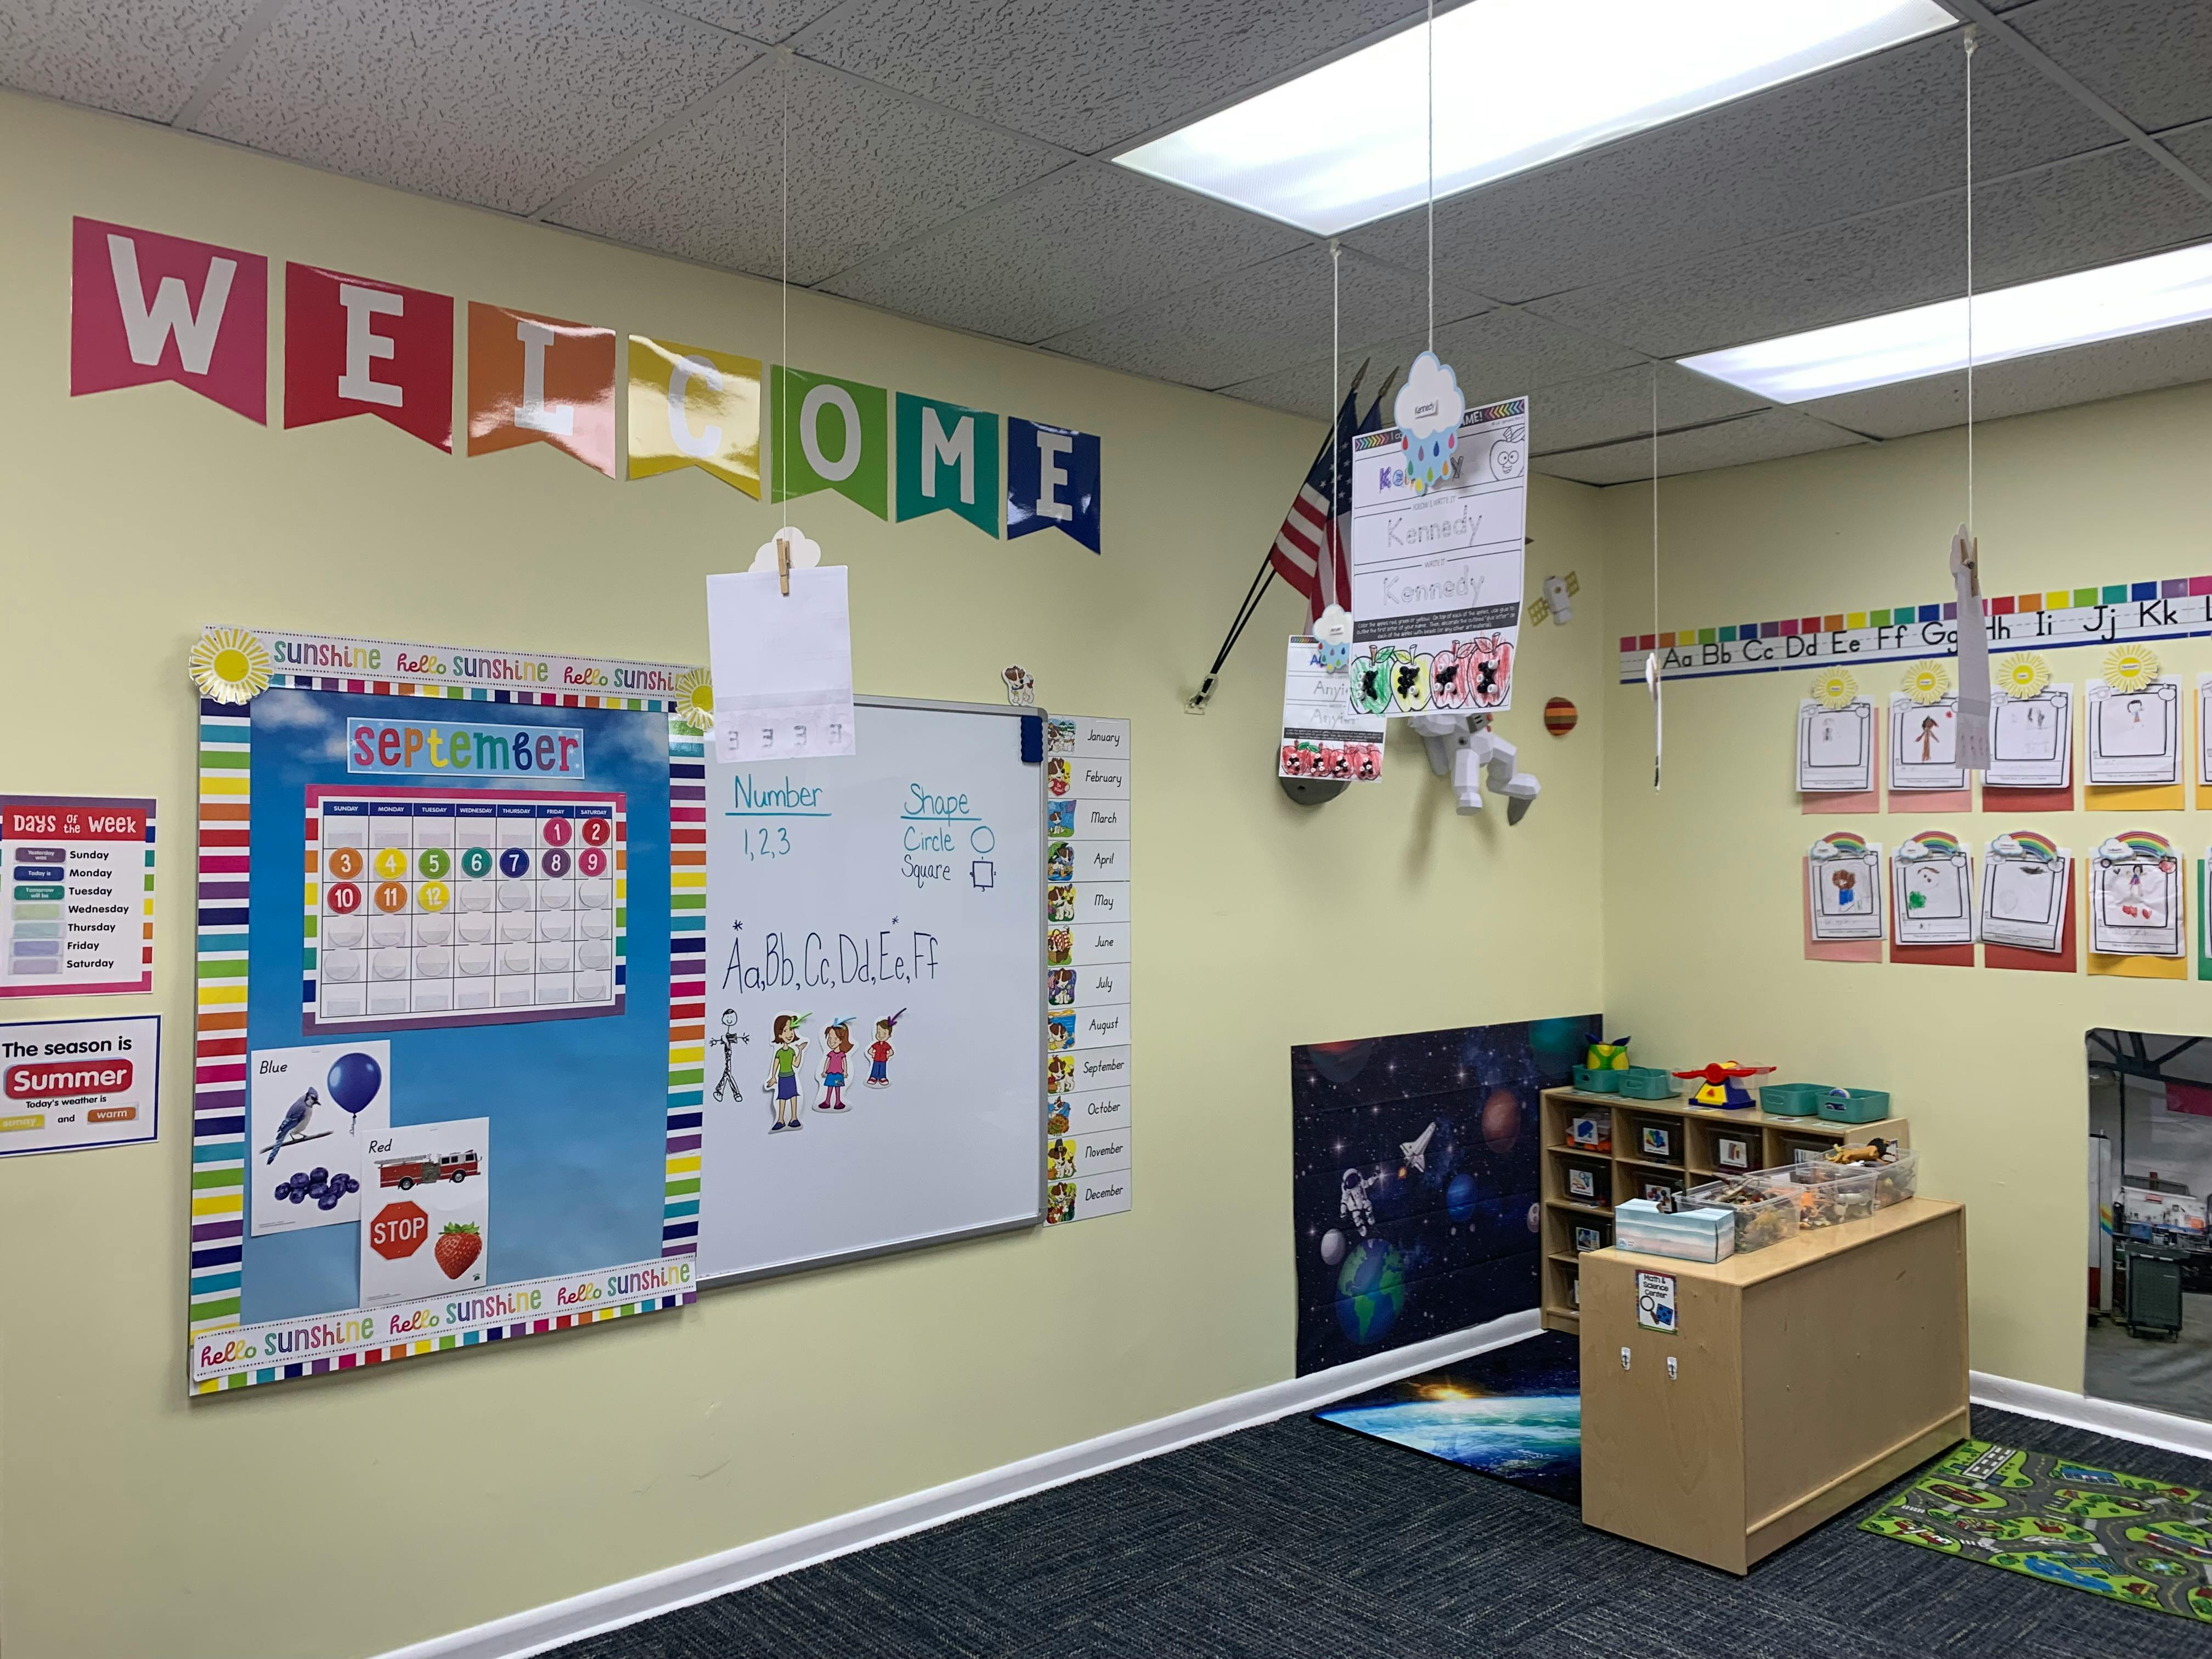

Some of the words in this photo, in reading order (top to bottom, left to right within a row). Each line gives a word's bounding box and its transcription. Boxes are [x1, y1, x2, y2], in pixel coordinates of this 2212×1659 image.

[106, 233, 1073, 522] WELCOME
[1388, 505, 1482, 548] Kennedy
[1383, 565, 1485, 608] Kennedy
[1663, 647, 1692, 669] Aa
[1702, 643, 1731, 665] Bb
[1743, 640, 1774, 661] Cc
[1786, 633, 1816, 658] Dd
[1832, 630, 1860, 654] Ee
[1877, 625, 1908, 650] Ff
[2036, 611, 2052, 636] Ii
[2084, 605, 2116, 641] Jj
[2140, 599, 2178, 627] Kk
[274, 640, 381, 670] sunshine
[397, 652, 447, 675] hello
[453, 656, 548, 682] sunshine
[564, 665, 608, 686] hello
[1087, 730, 1120, 747] January
[1085, 770, 1122, 788] February
[735, 774, 822, 809] Number
[904, 783, 970, 827] Shape
[1091, 812, 1117, 824] March
[554, 823, 561, 840] 1
[592, 823, 600, 840] 2
[744, 827, 790, 861] 1,2,3
[904, 826, 955, 852] Circle
[69, 851, 109, 861] Sunday
[341, 854, 351, 871] 3
[385, 855, 396, 871] 4
[430, 855, 439, 872] 5
[472, 854, 482, 870] 6
[510, 855, 520, 872] 7
[551, 854, 560, 871] 8
[588, 854, 597, 870] 9
[1094, 853, 1115, 869] April
[69, 869, 112, 879] Monday
[901, 855, 951, 888] Square
[69, 887, 112, 897] Tuesday
[335, 889, 354, 907] 10
[385, 888, 397, 906] 11
[426, 888, 442, 905] 12
[68, 905, 129, 915] Wednesday
[1094, 894, 1114, 910] May
[67, 923, 116, 933] Thursday
[67, 941, 99, 951] Friday
[1094, 936, 1114, 947] June
[66, 960, 114, 969] Saturday
[1096, 977, 1113, 992] July
[1088, 1017, 1119, 1035] August
[2, 1041, 38, 1058] The
[44, 1040, 112, 1055] season
[118, 1036, 132, 1051] is
[259, 1061, 287, 1074] Blue
[1083, 1059, 1125, 1077] September
[14, 1069, 127, 1092] Summer
[26, 1098, 59, 1109] Today's
[61, 1096, 98, 1106] weather
[1088, 1103, 1121, 1115] October
[58, 1114, 75, 1123] and
[97, 1109, 128, 1119] warm
[369, 1139, 392, 1154] Red
[1085, 1144, 1124, 1158] November
[1085, 1186, 1124, 1201] December
[374, 1217, 425, 1245] STOP
[1643, 1282, 1669, 1291] Science
[1645, 1289, 1668, 1299] Center
[201, 1340, 257, 1367] hello
[264, 1317, 374, 1356] sunshine
[390, 1309, 439, 1334] hello
[447, 1289, 541, 1324] sunshine
[558, 1282, 601, 1306] hello
[608, 1263, 690, 1296] sunshine
